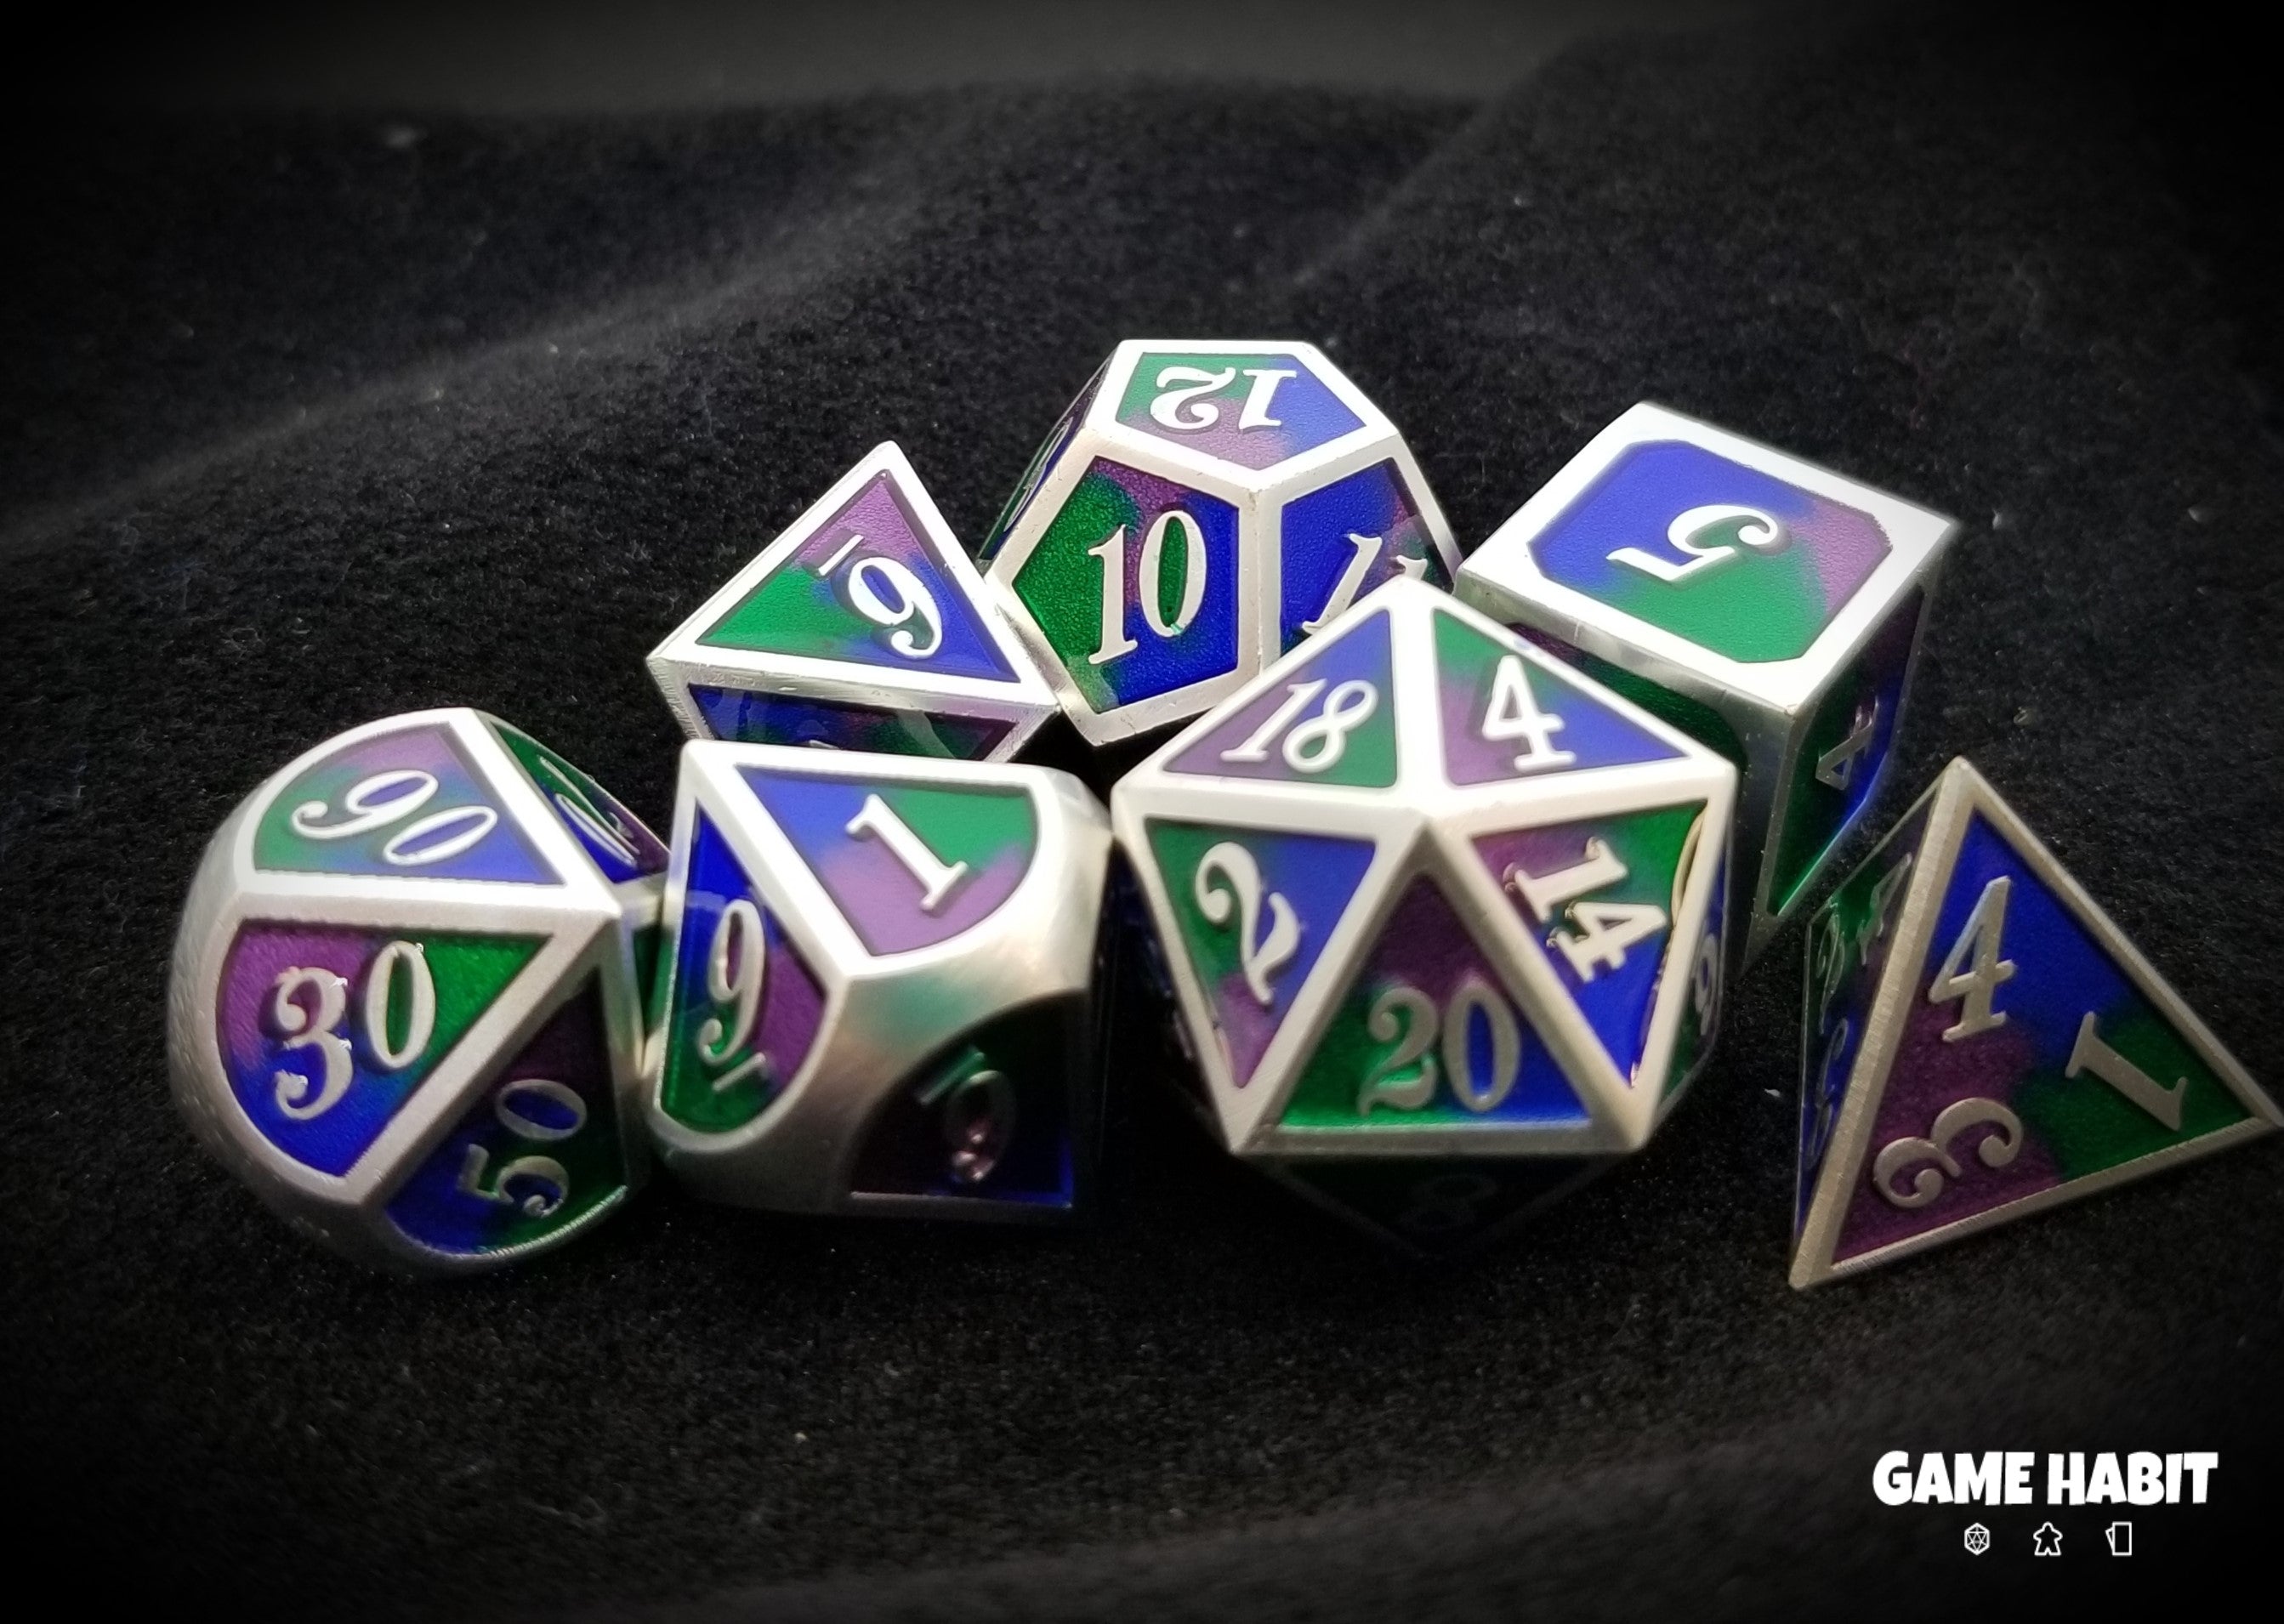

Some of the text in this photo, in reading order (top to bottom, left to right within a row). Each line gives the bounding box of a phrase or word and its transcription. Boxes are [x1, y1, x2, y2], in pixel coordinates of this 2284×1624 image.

[1150, 366, 1298, 430] 12
[1088, 508, 1207, 665] 10
[1605, 504, 1779, 582] 5
[1220, 678, 1379, 774] 18
[1481, 654, 1577, 773] 4
[290, 769, 498, 866] 90
[845, 792, 969, 912] 1
[1194, 841, 1301, 1007] 2
[1503, 835, 1668, 983] 14
[1927, 874, 2020, 1043] 4
[273, 940, 436, 1121] 30
[695, 898, 765, 1067] 9
[1356, 978, 1523, 1117] 20
[2064, 1009, 2189, 1133] 1
[456, 1077, 588, 1217] 50
[1872, 1096, 2025, 1209] 3
